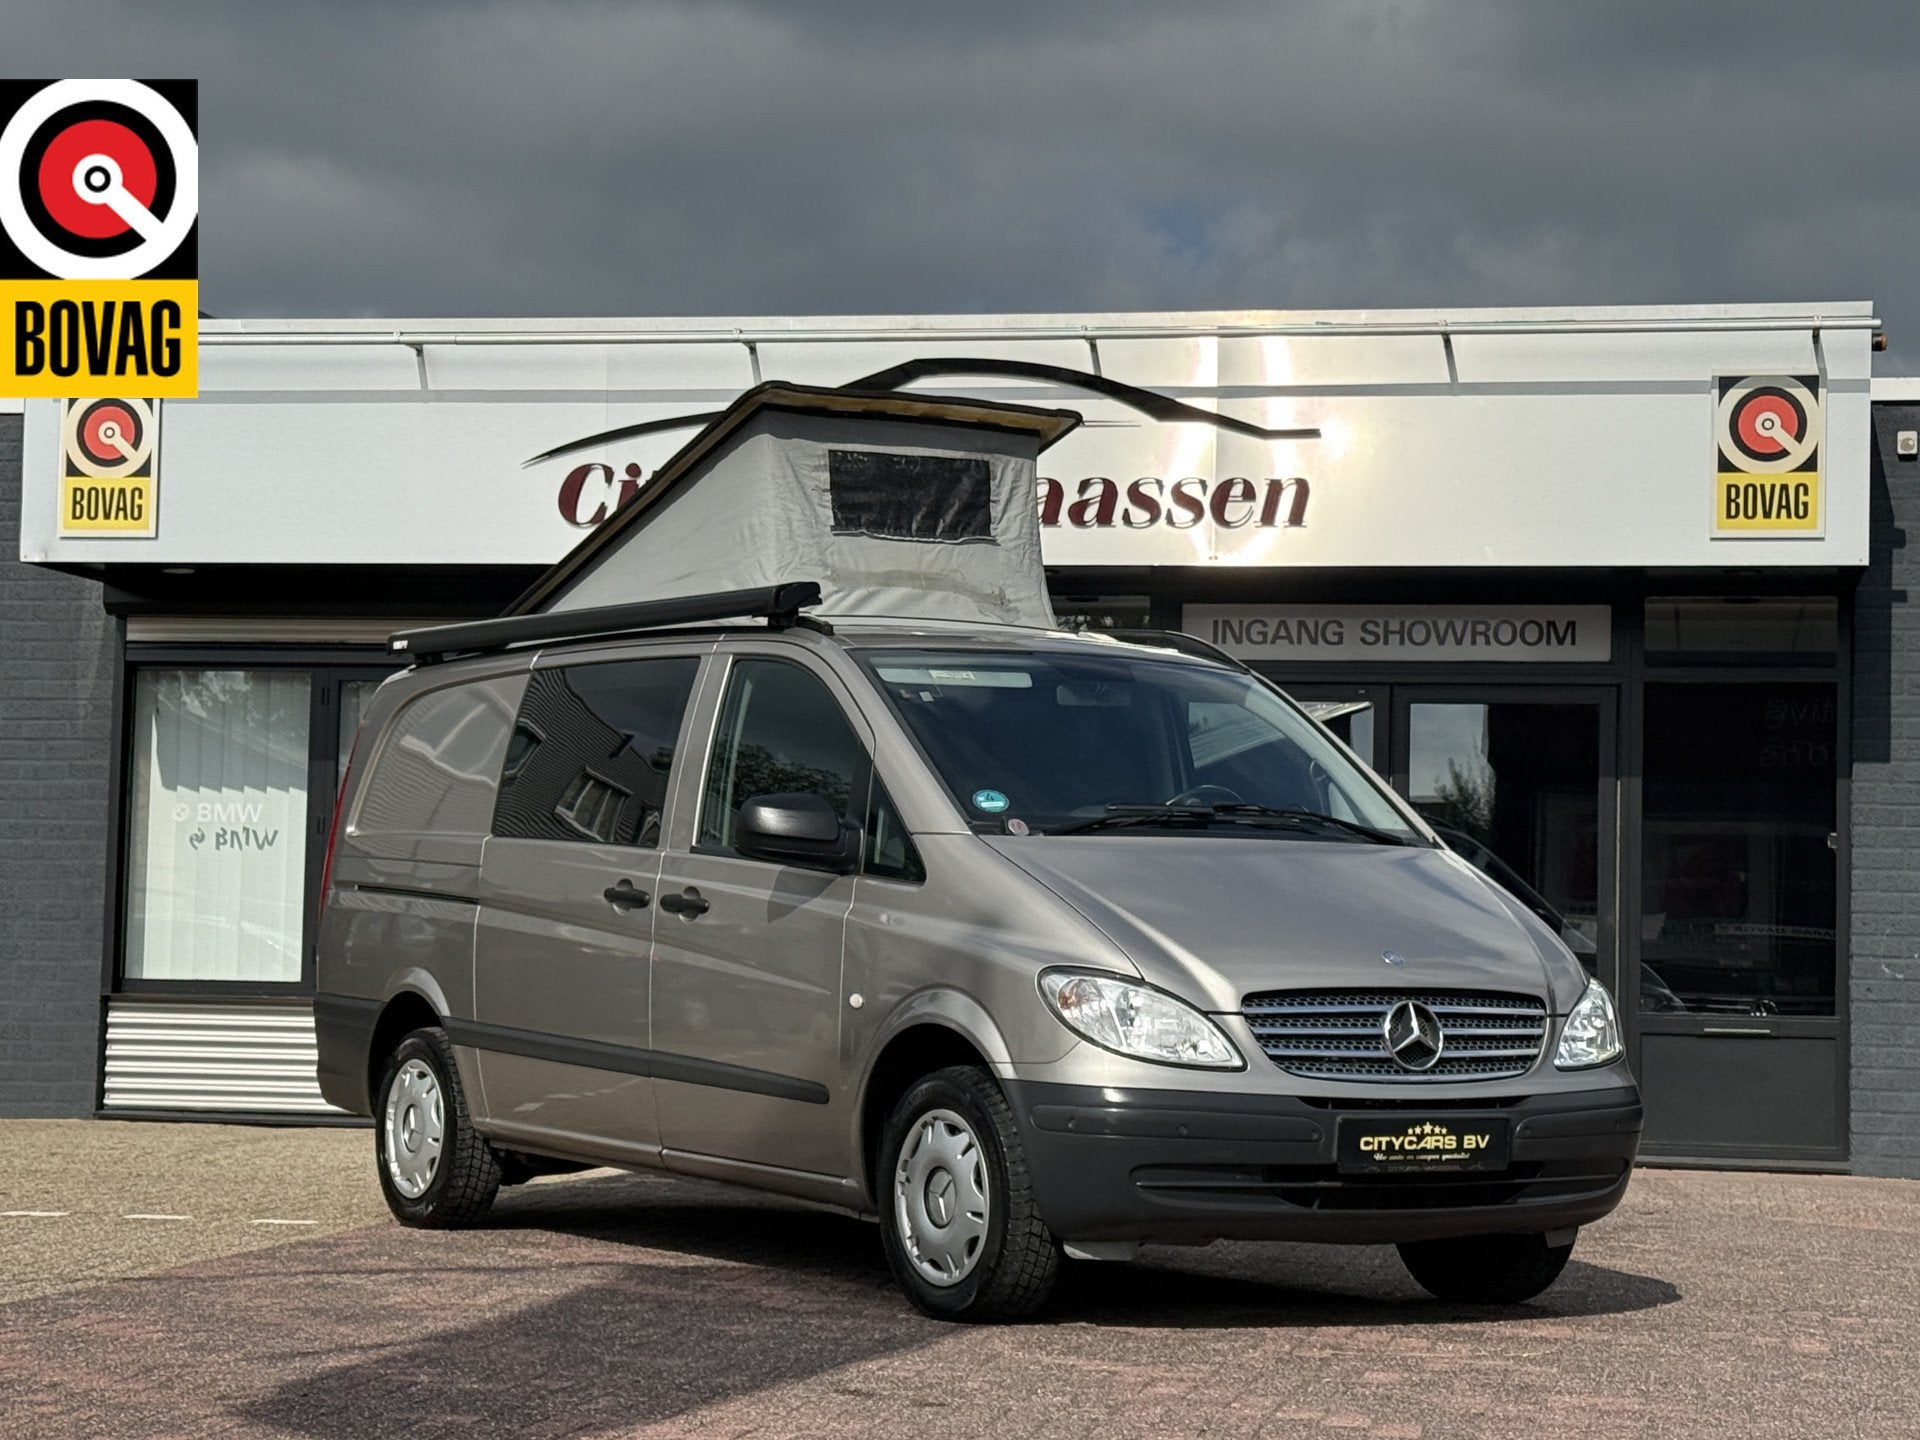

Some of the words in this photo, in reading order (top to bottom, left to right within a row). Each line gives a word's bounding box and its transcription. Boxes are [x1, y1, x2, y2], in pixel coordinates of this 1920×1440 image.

[71, 486, 144, 522] BOVAG
[557, 462, 656, 530] Ci
[1036, 476, 1312, 530] aassen
[1725, 482, 1810, 520] BOVAG
[1211, 618, 1345, 646] INGANG
[1359, 618, 1578, 647] SHOWROOM
[196, 802, 264, 823] BMW
[1359, 1134, 1457, 1151] CITYCARS
[1463, 1134, 1490, 1149] BV
